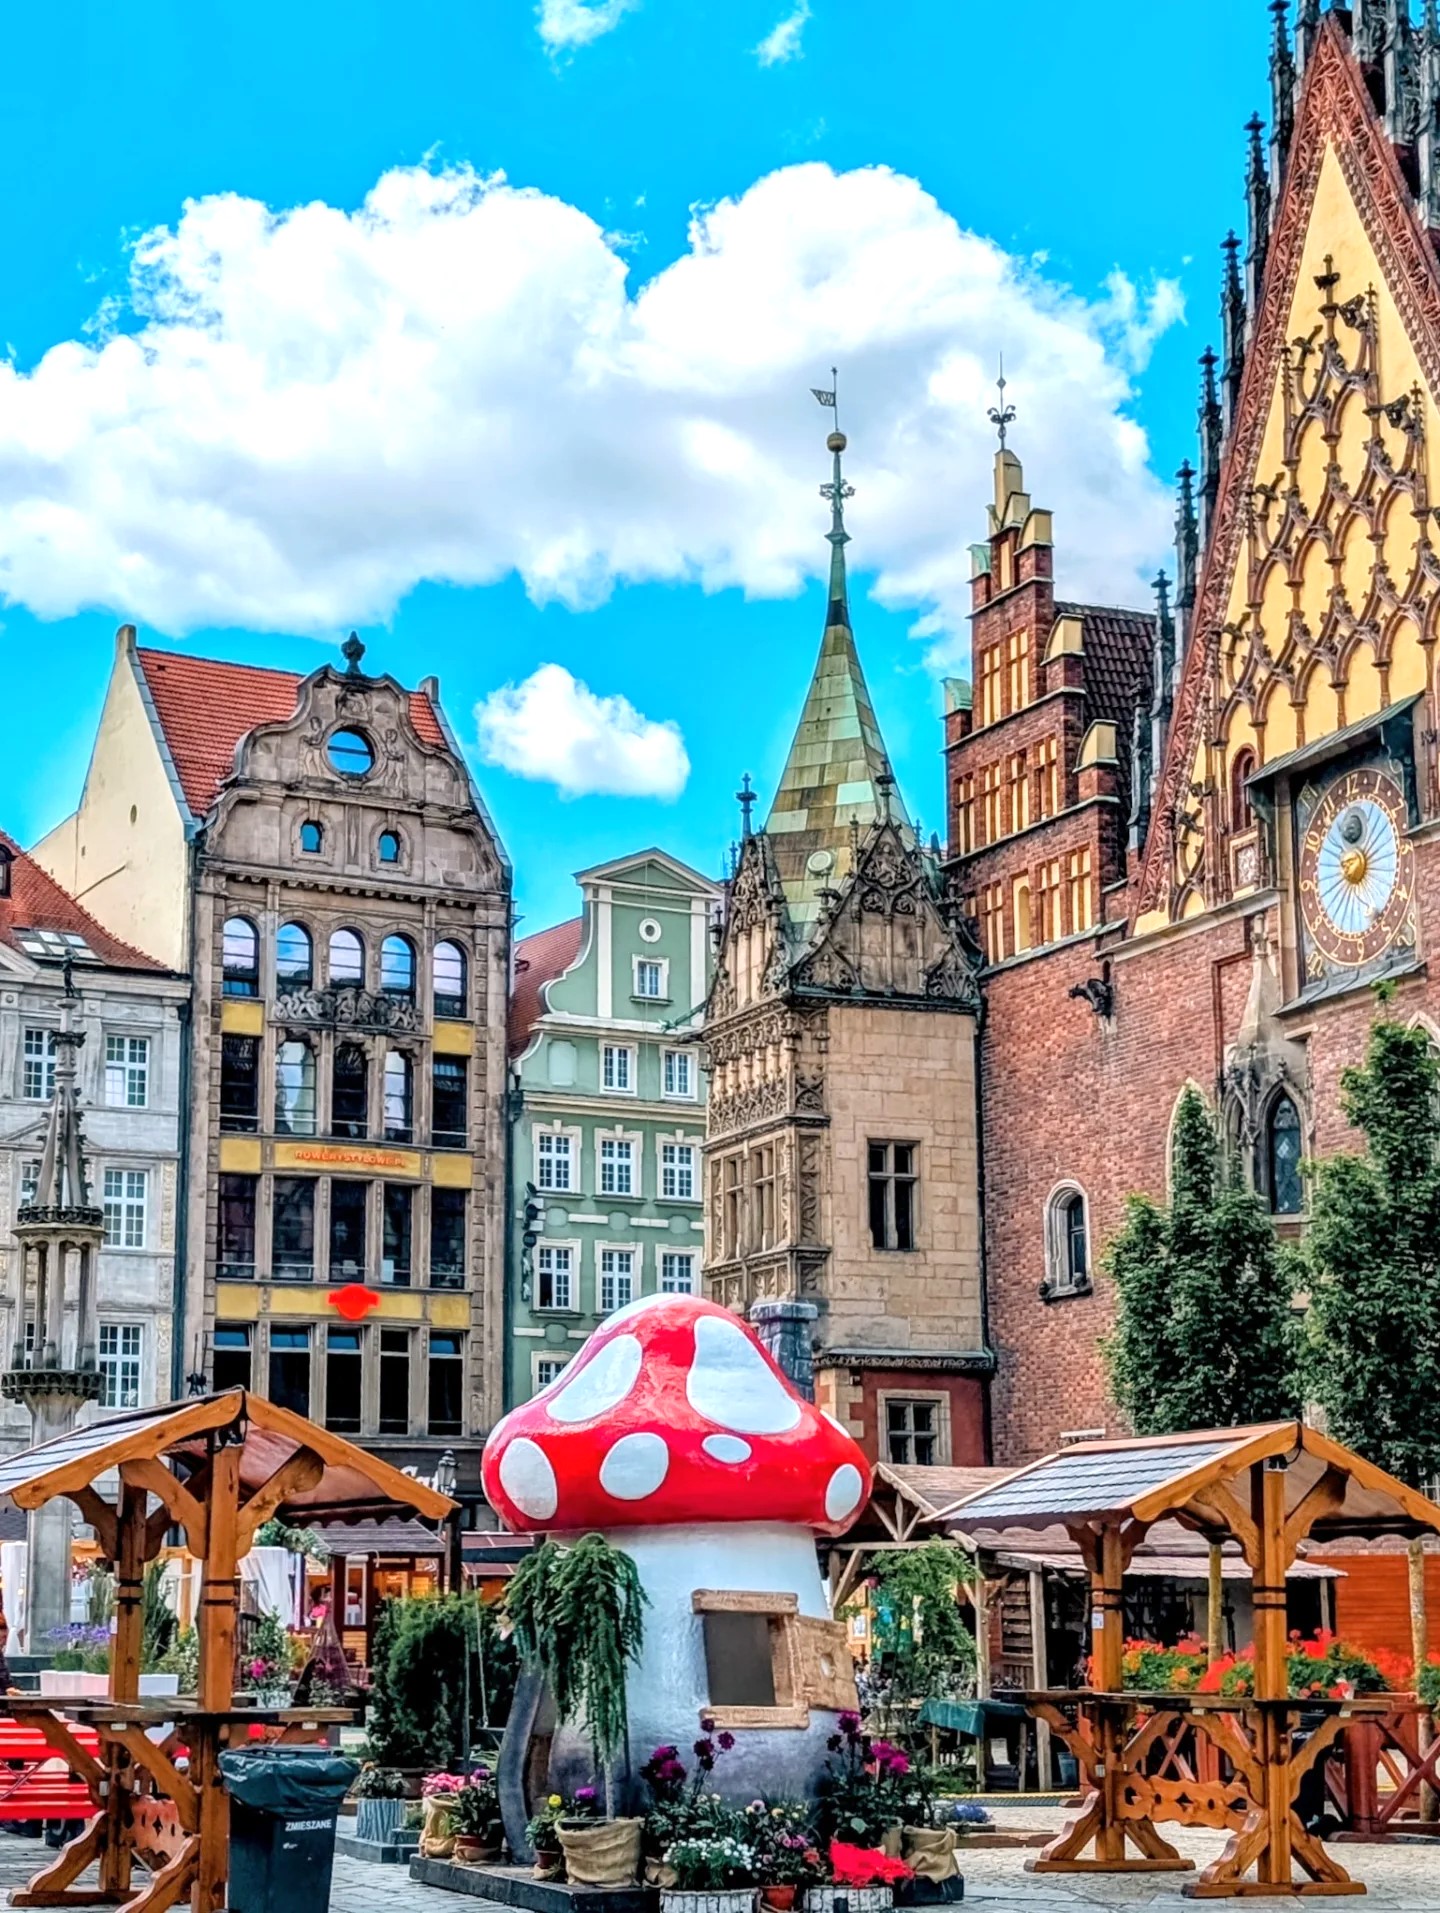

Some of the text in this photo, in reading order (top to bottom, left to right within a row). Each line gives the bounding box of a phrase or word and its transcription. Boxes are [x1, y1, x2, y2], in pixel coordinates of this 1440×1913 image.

[1345, 773, 1359, 797] 12
[1373, 774, 1382, 794] 1
[1391, 797, 1405, 819] 2
[1305, 830, 1320, 852] 10
[1400, 839, 1413, 855] 3
[1300, 879, 1315, 891] 9
[1396, 884, 1408, 902] 4
[1311, 915, 1322, 932] 8
[1381, 920, 1392, 941] 5
[1330, 939, 1341, 958] 7
[1356, 939, 1365, 962] 6
[285, 1819, 332, 1832] ZMIESZANE
